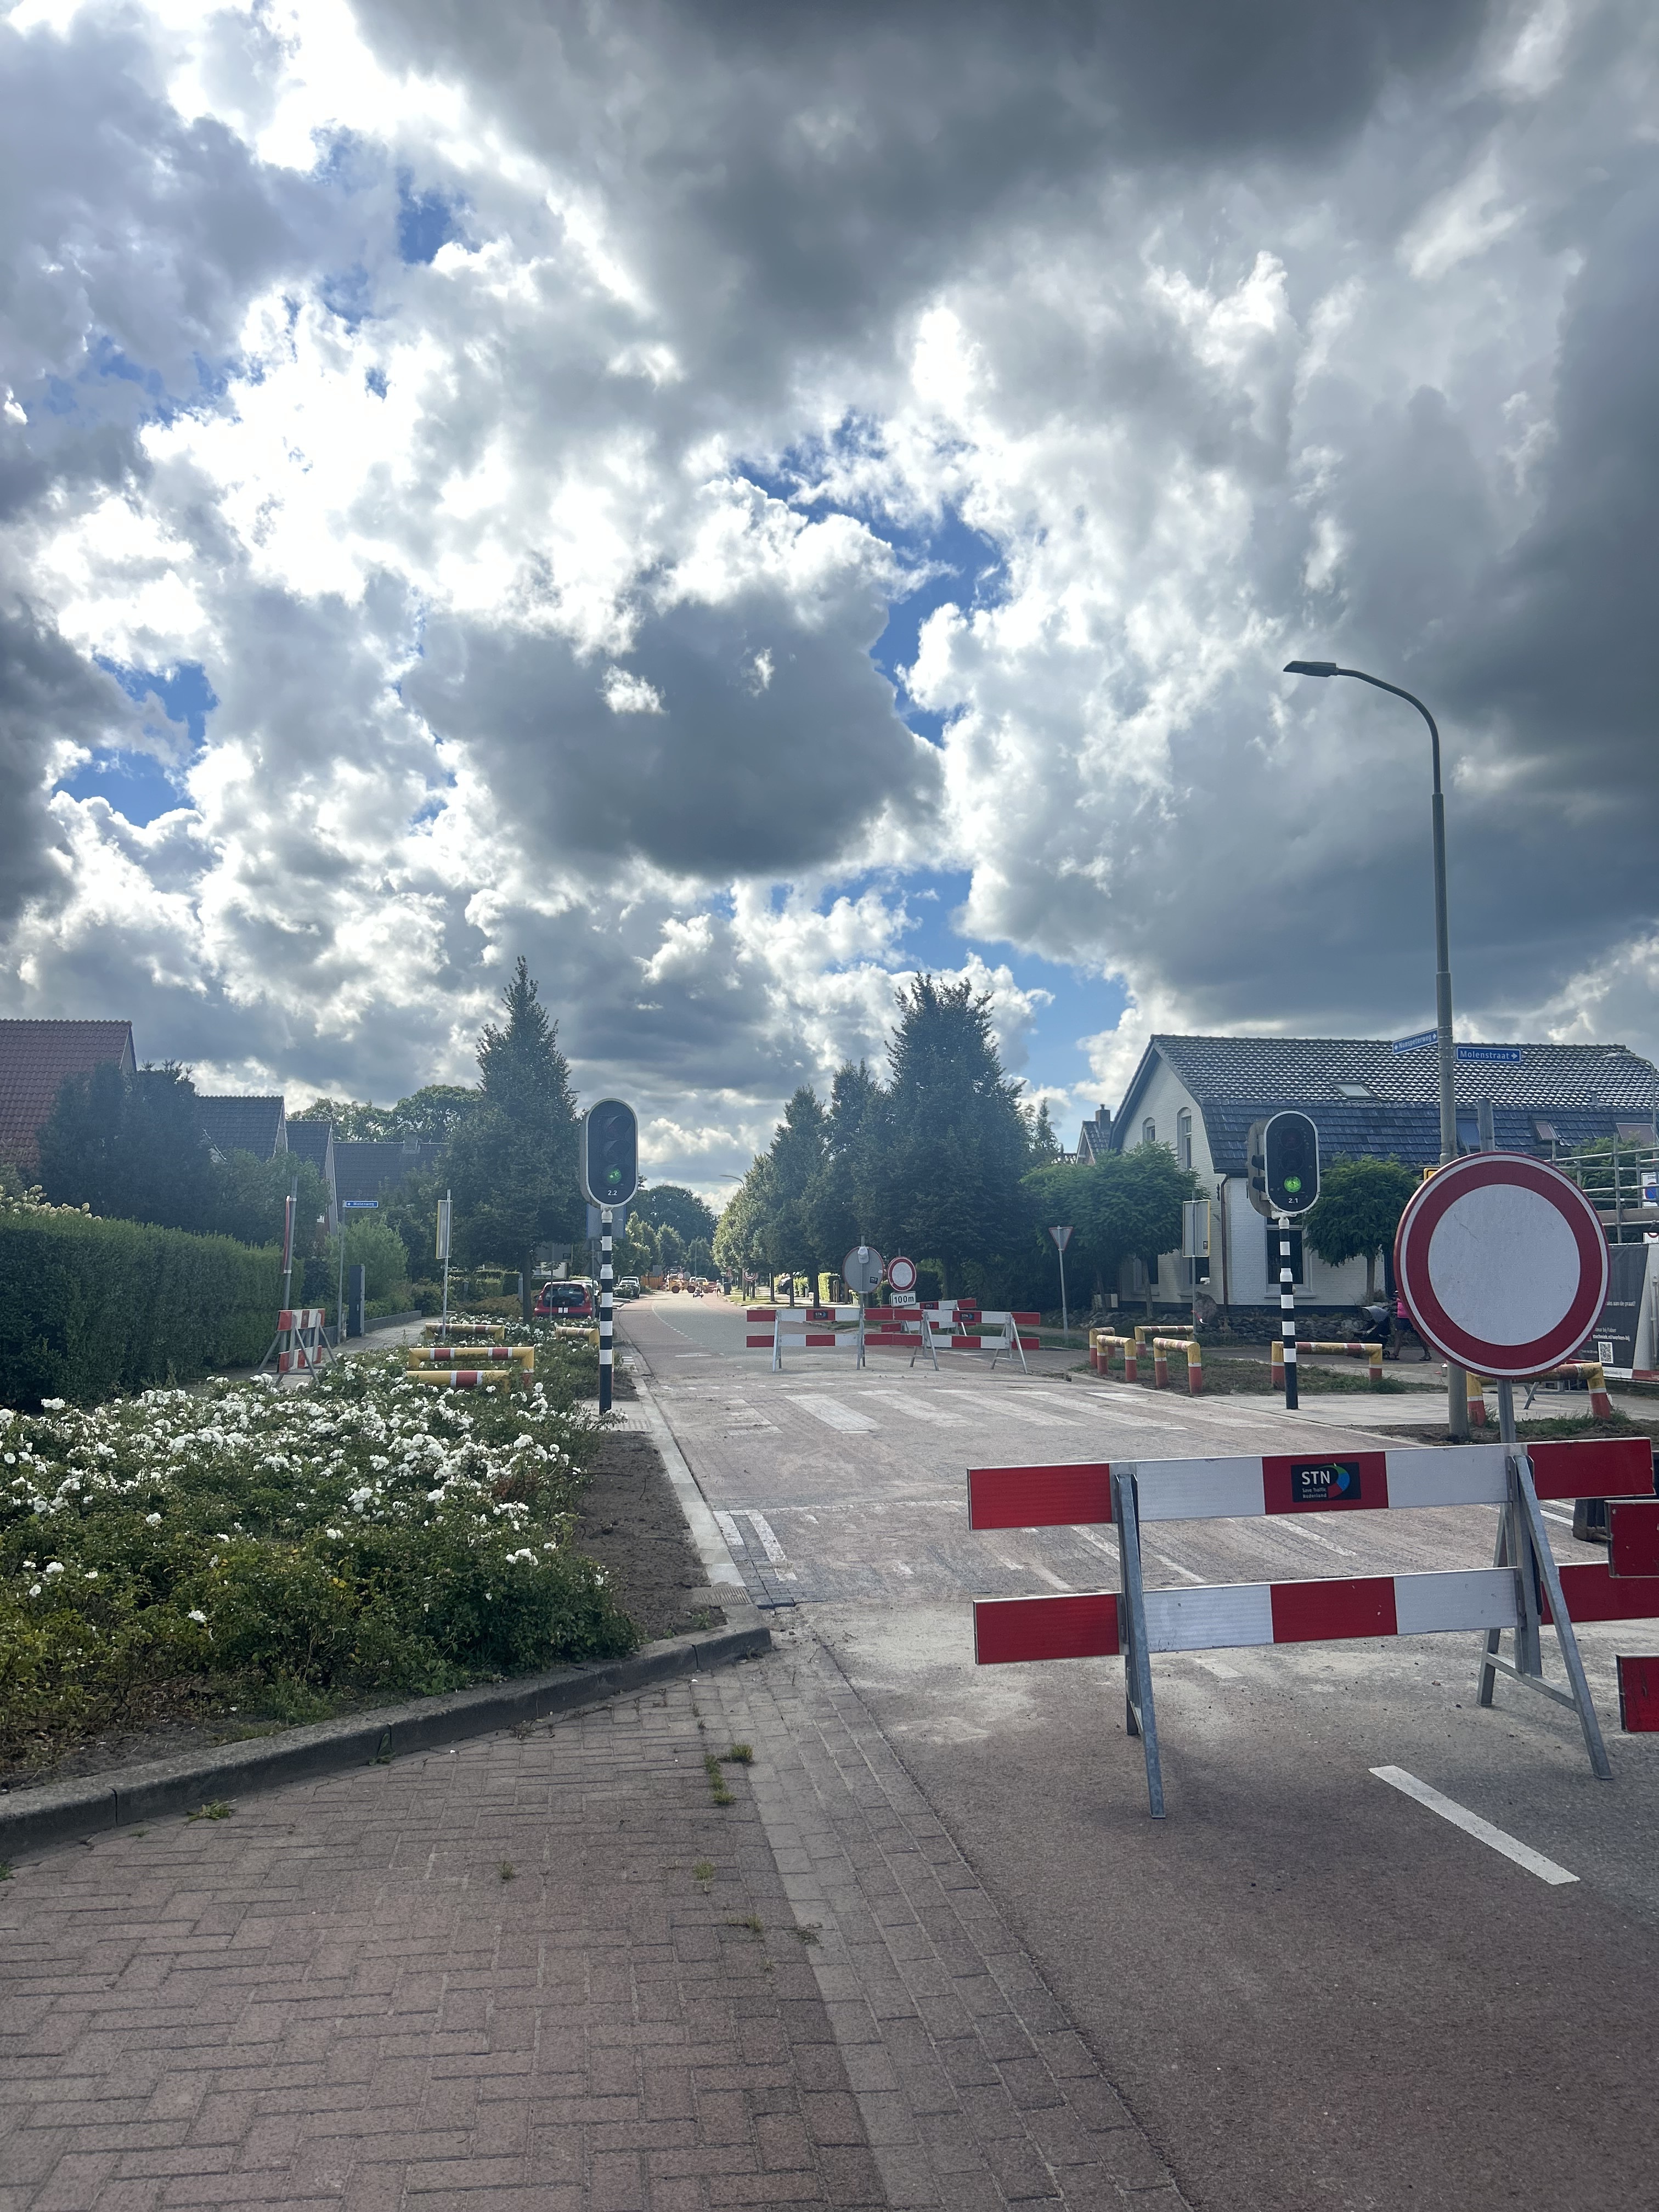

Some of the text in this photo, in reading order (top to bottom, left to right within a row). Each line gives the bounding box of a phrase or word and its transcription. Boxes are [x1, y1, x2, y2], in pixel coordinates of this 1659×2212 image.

[1398, 1035, 1431, 1048] Nunspeterweg
[1460, 1050, 1510, 1059] Molenstraat
[894, 1295, 914, 1304] 100m
[1302, 1471, 1330, 1485] STN
